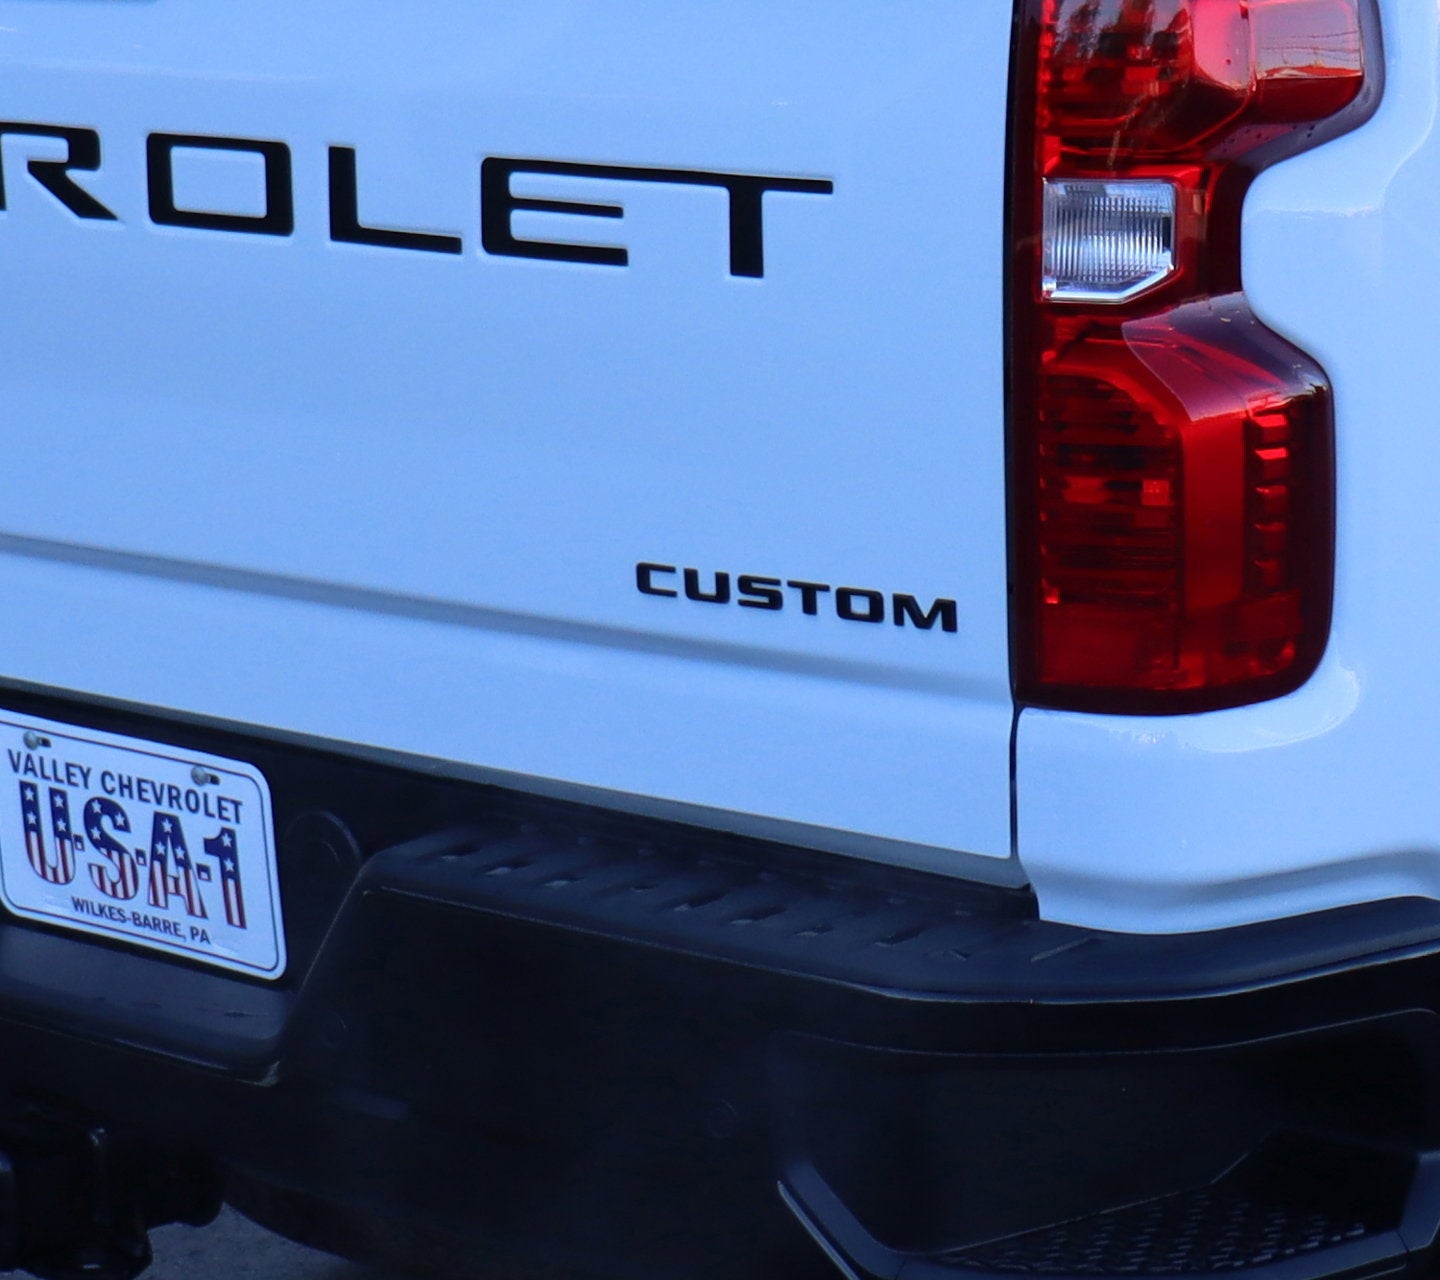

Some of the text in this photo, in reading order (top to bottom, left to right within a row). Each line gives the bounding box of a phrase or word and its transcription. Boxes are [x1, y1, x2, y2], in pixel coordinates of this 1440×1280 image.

[635, 562, 958, 634] CUSTOM
[7, 748, 244, 825] VALLEY CHEVROLET
[71, 895, 212, 945] WILKES-BARRE, PA
